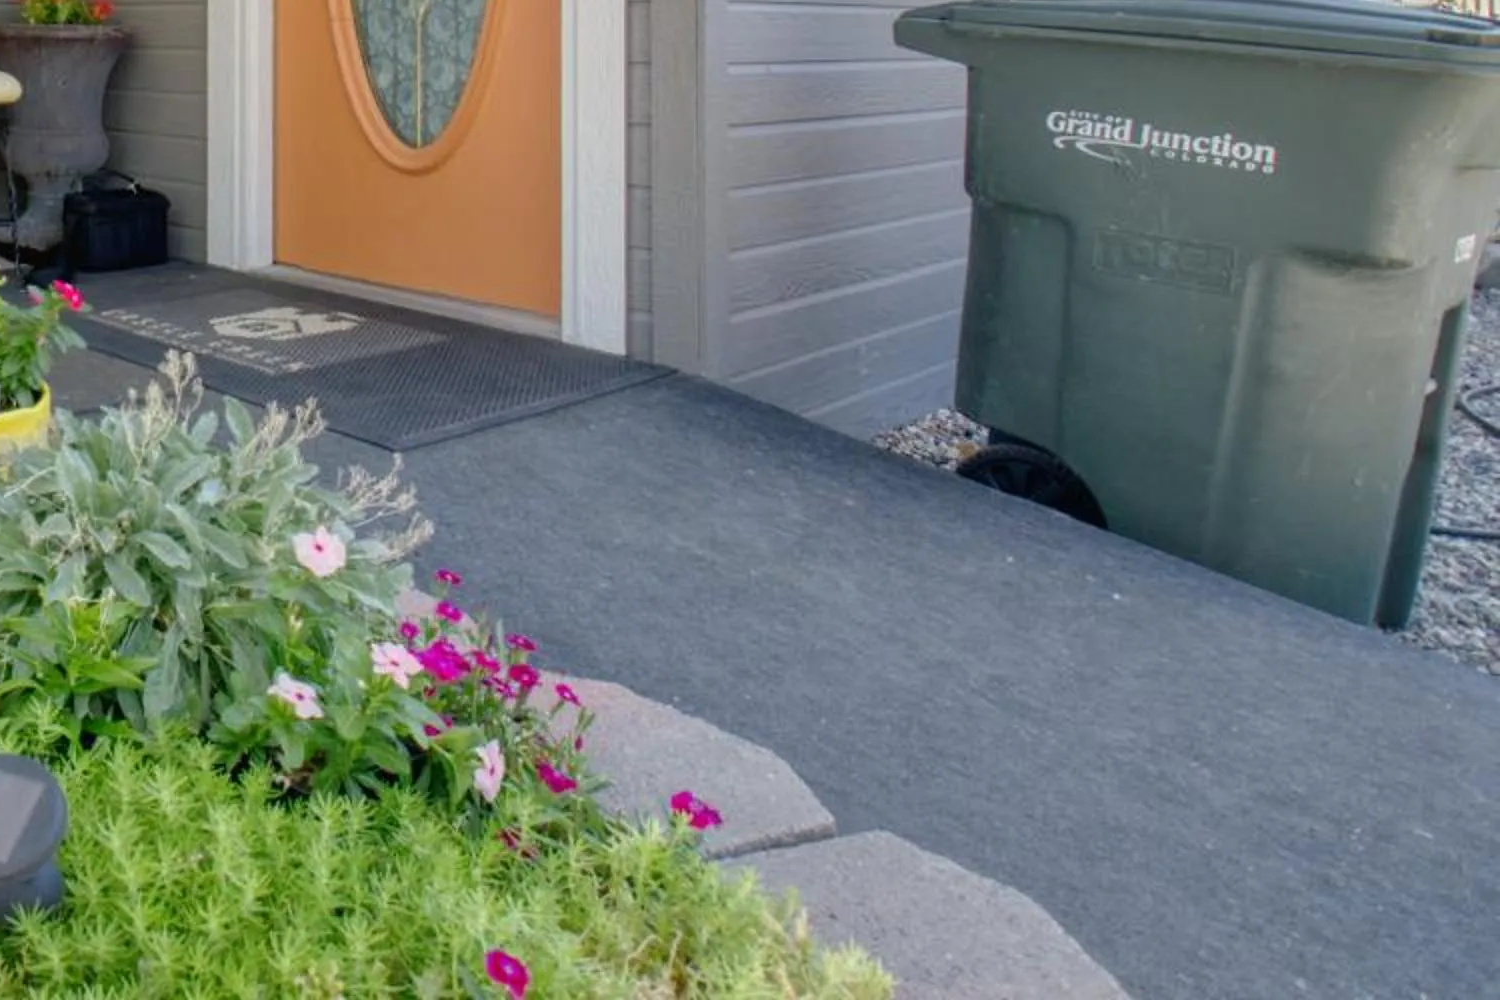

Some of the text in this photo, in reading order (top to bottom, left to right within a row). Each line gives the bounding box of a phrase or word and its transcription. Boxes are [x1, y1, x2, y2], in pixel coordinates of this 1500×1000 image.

[1046, 111, 1276, 164] Grand Junction
[1150, 148, 1276, 174] COLORADO
